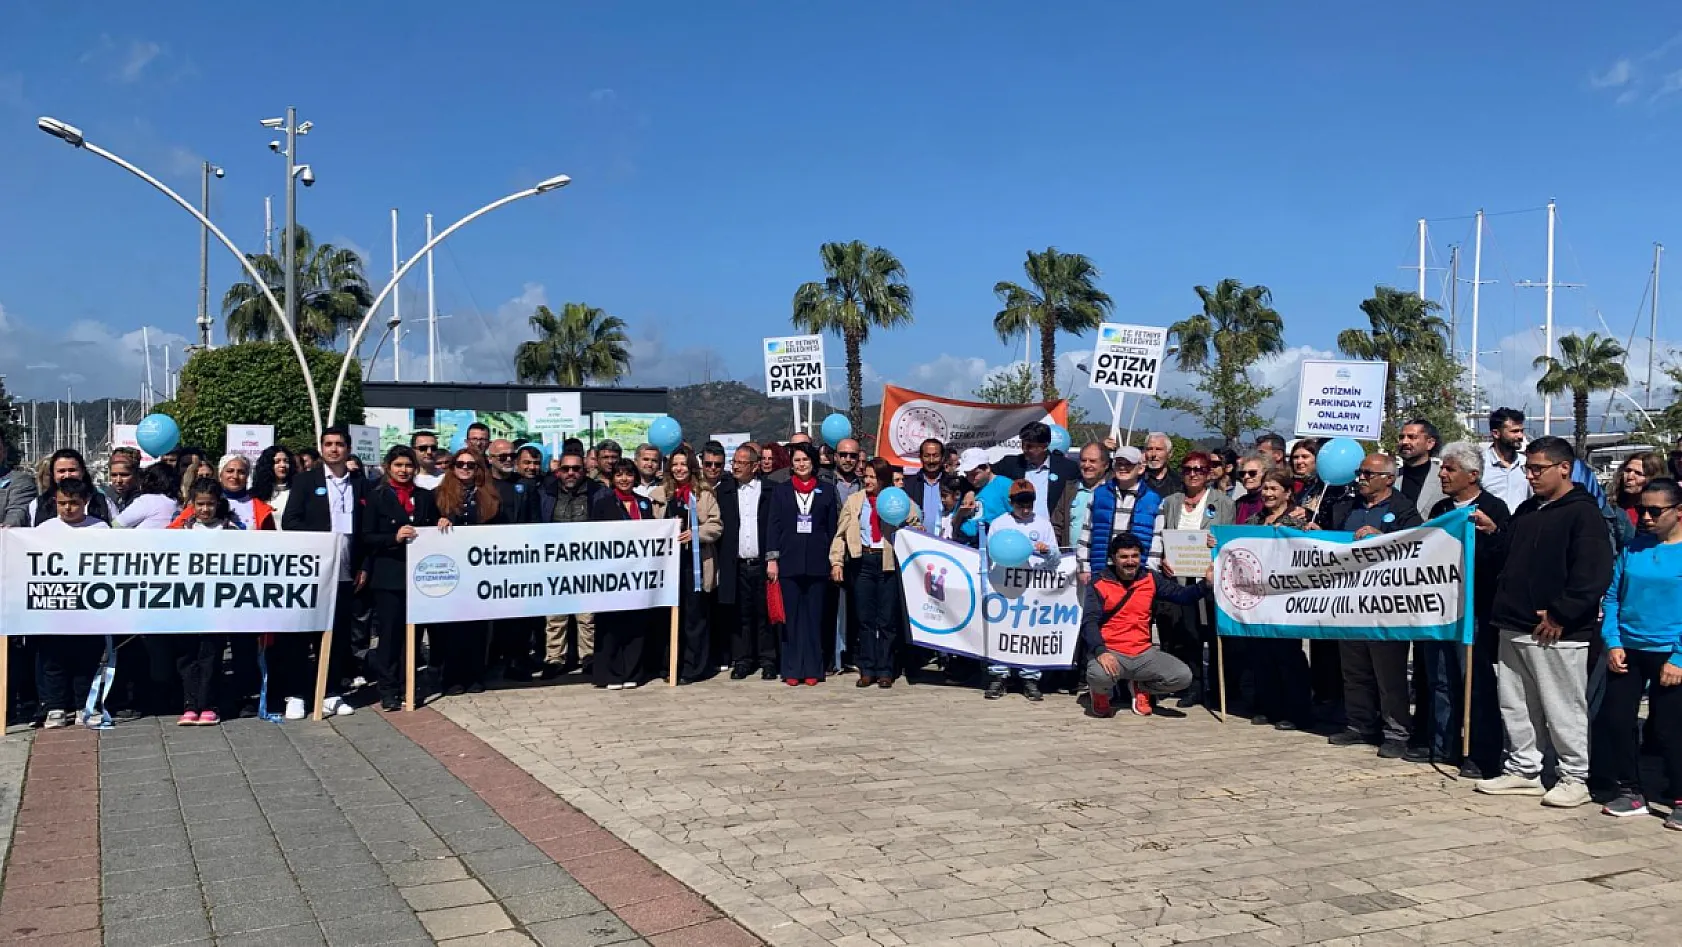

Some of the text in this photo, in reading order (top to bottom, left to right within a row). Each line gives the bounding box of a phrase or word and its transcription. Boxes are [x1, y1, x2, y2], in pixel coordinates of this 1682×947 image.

[771, 376, 822, 393] PARKI
[1094, 369, 1153, 389] PARKI
[1308, 398, 1373, 409] FARKINDAYIZ
[1317, 410, 1361, 420] ONLARIN
[26, 551, 69, 577] T.C.
[467, 543, 540, 567] Otizmin
[1290, 544, 1342, 568] MUĞLA
[1351, 539, 1423, 564] FETHİYE
[476, 577, 544, 600] Onların
[1268, 564, 1462, 590] ÖZEL EĞİTİM UYGULAMA
[32, 595, 78, 609] METE
[213, 582, 319, 609] PARKI
[1285, 595, 1330, 614] OKULU
[1358, 591, 1445, 617] KADEME)
[981, 592, 1079, 629] Otizm
[998, 630, 1063, 655] DERNEĞİ
